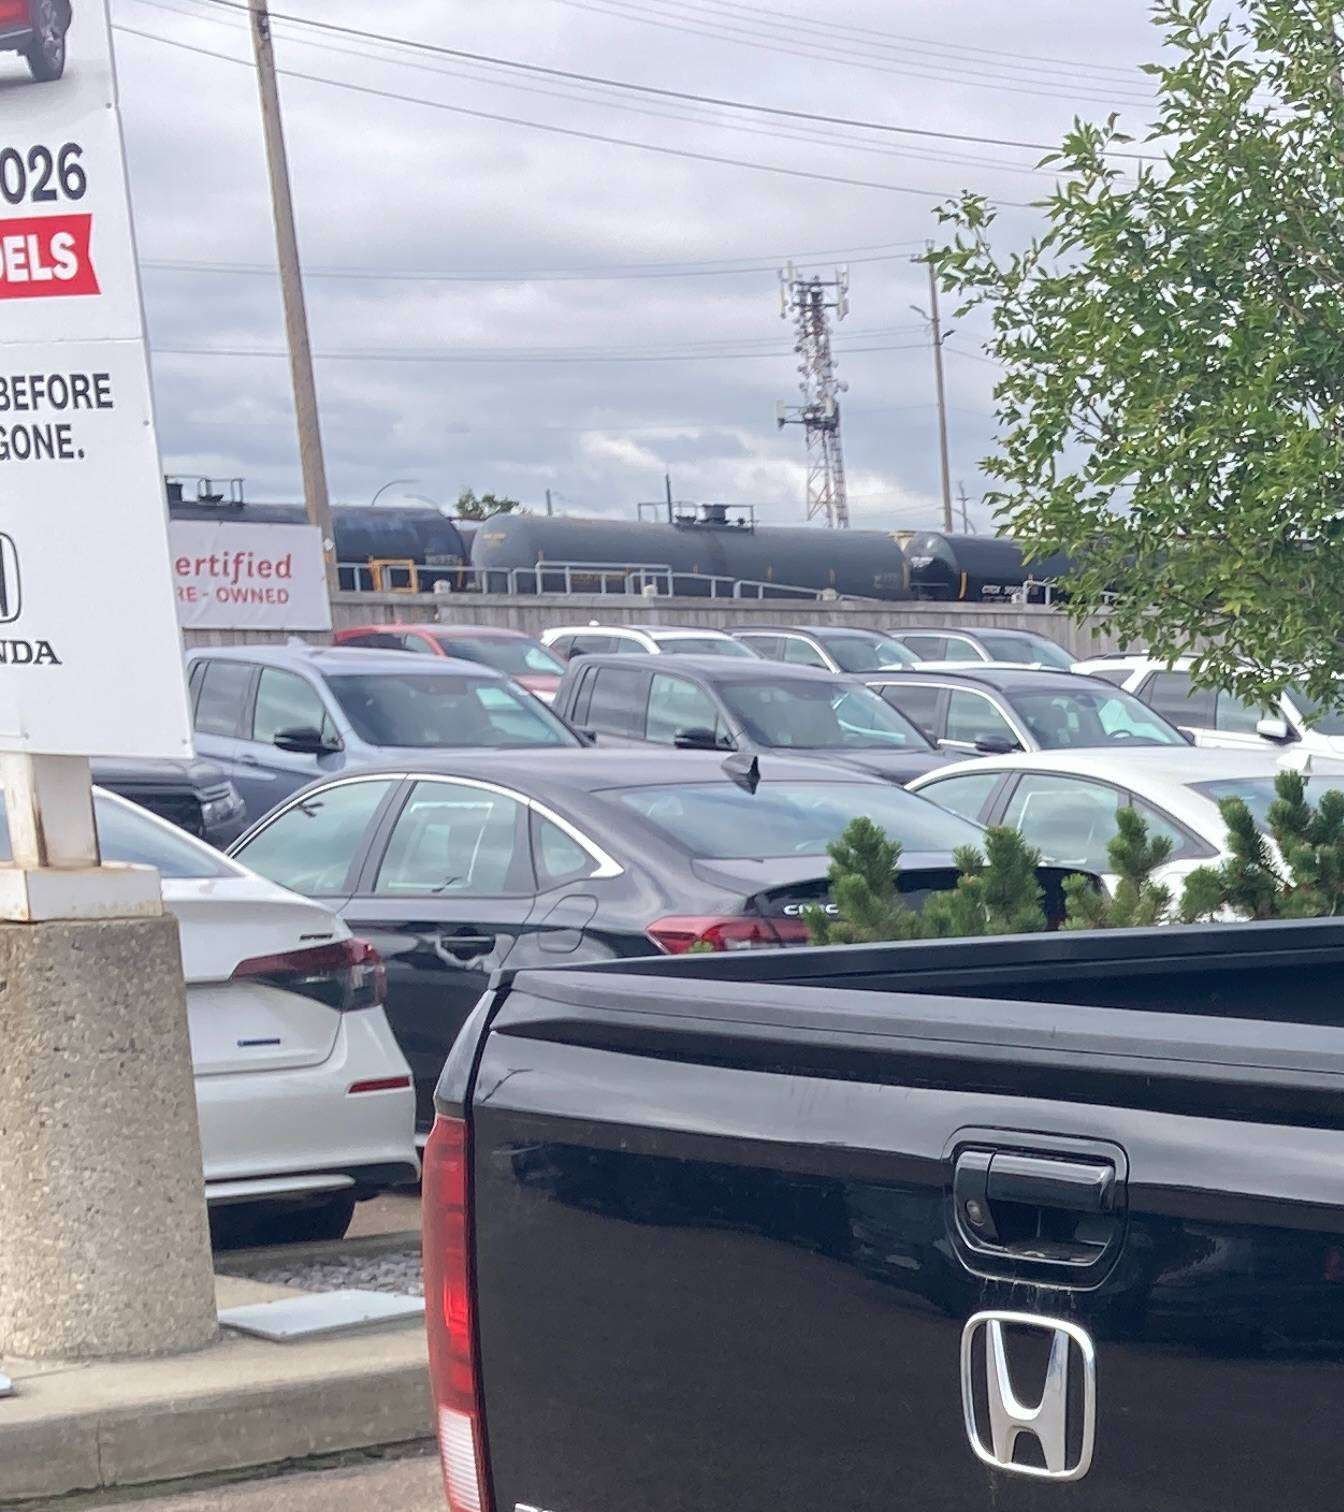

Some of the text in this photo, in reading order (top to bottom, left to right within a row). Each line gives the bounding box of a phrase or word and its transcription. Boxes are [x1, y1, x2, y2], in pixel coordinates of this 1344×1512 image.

[0, 142, 87, 204] 026
[0, 231, 78, 282] ELS
[0, 373, 114, 411] BEFORE
[216, 587, 289, 604] OWNED
